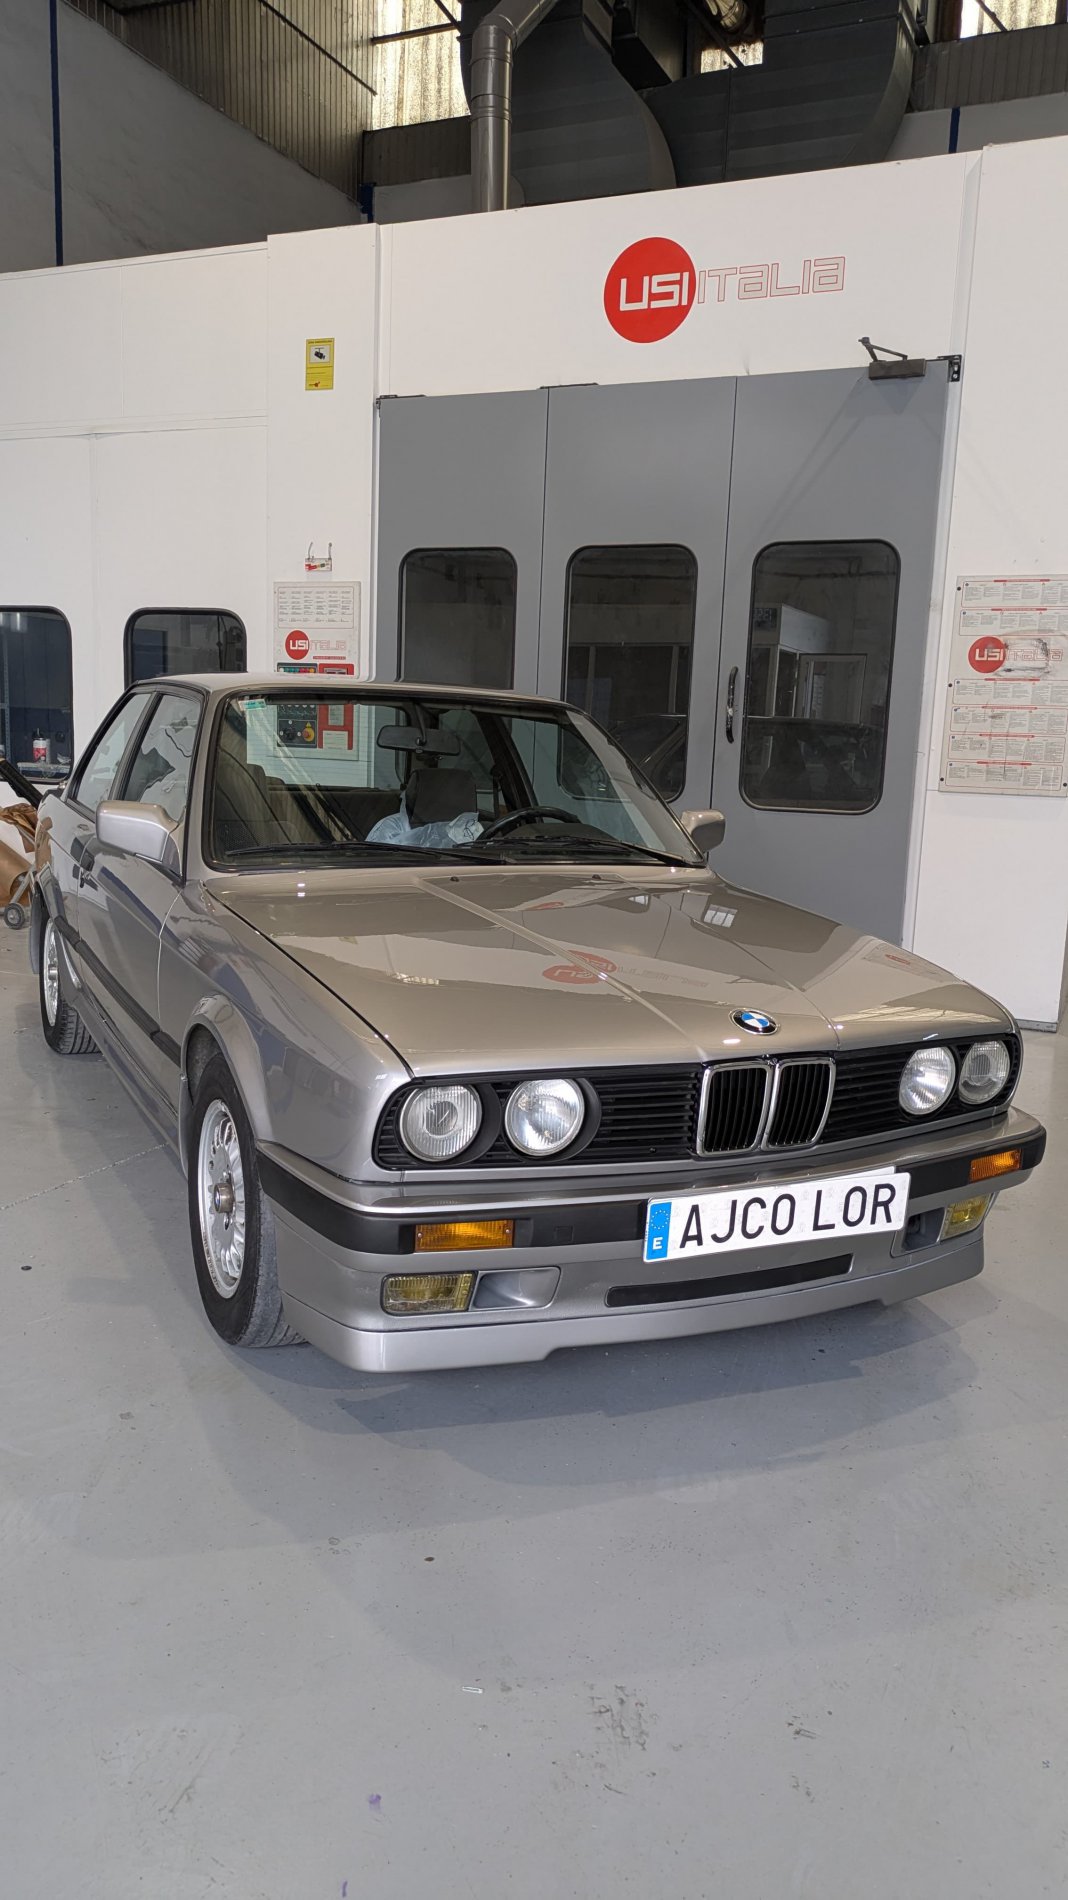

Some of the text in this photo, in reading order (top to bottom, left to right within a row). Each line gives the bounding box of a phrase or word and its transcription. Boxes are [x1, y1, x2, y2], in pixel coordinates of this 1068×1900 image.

[619, 271, 690, 312] USI
[289, 639, 309, 650] USI
[975, 648, 1004, 661] USI
[679, 1183, 896, 1249] AJCO LOR
[652, 1236, 664, 1250] E
